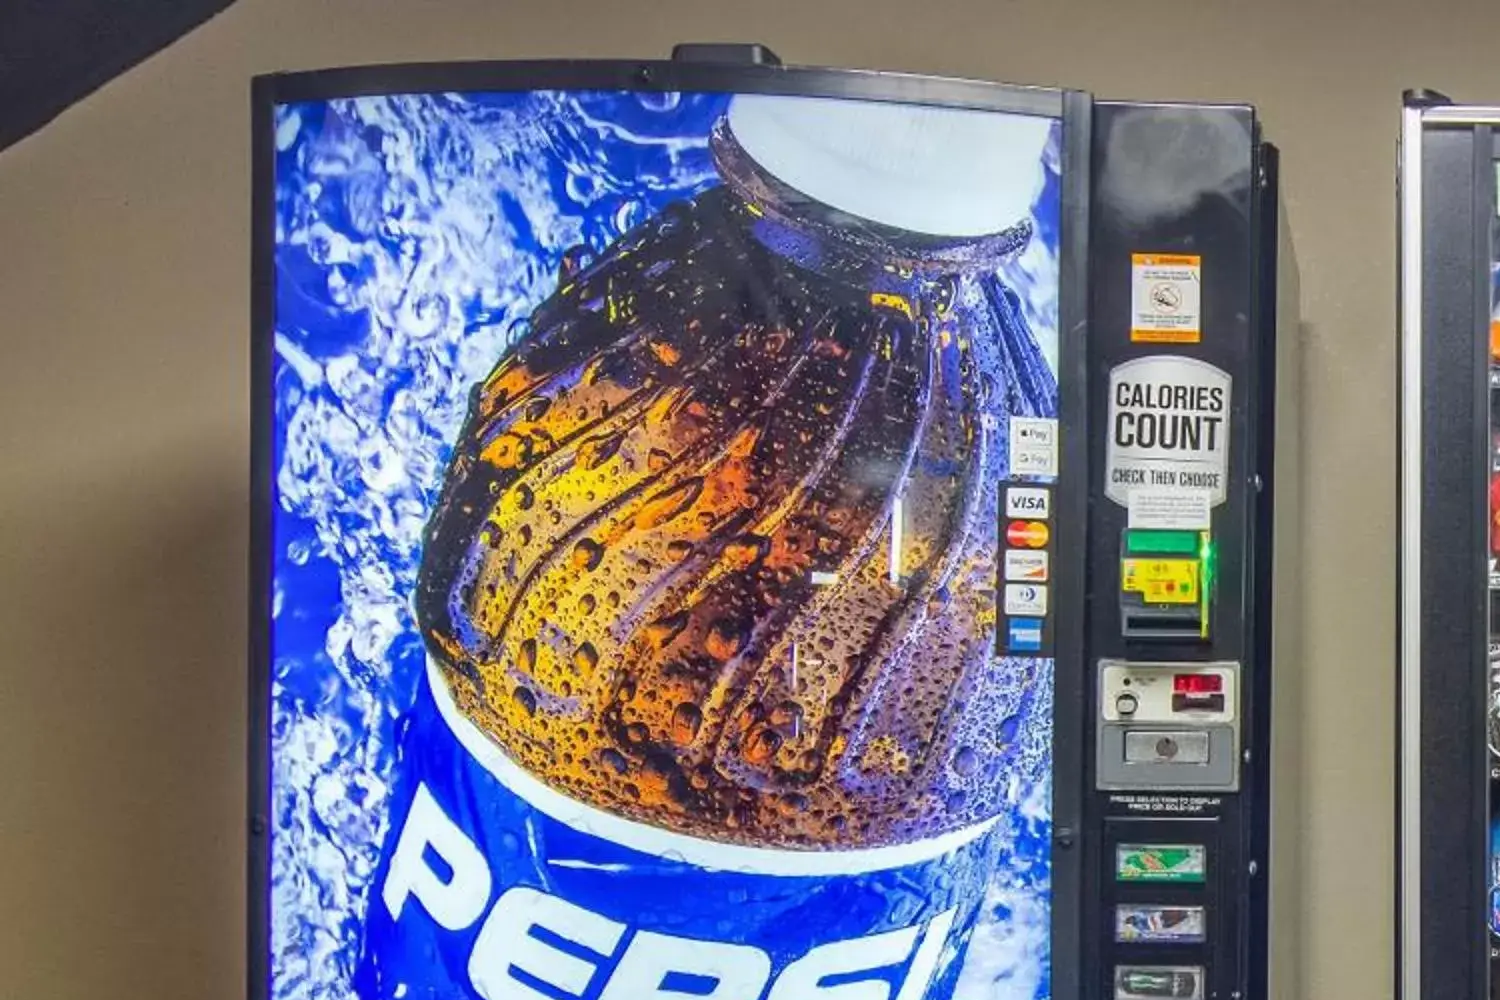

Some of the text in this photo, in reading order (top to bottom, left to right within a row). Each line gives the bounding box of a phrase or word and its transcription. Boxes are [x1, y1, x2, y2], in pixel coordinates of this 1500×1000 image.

[1115, 382, 1224, 413] CALORIES
[1114, 411, 1223, 451] COUNT
[1112, 468, 1221, 488] CHECK THEN CHOOSE
[1011, 496, 1045, 510] VISA
